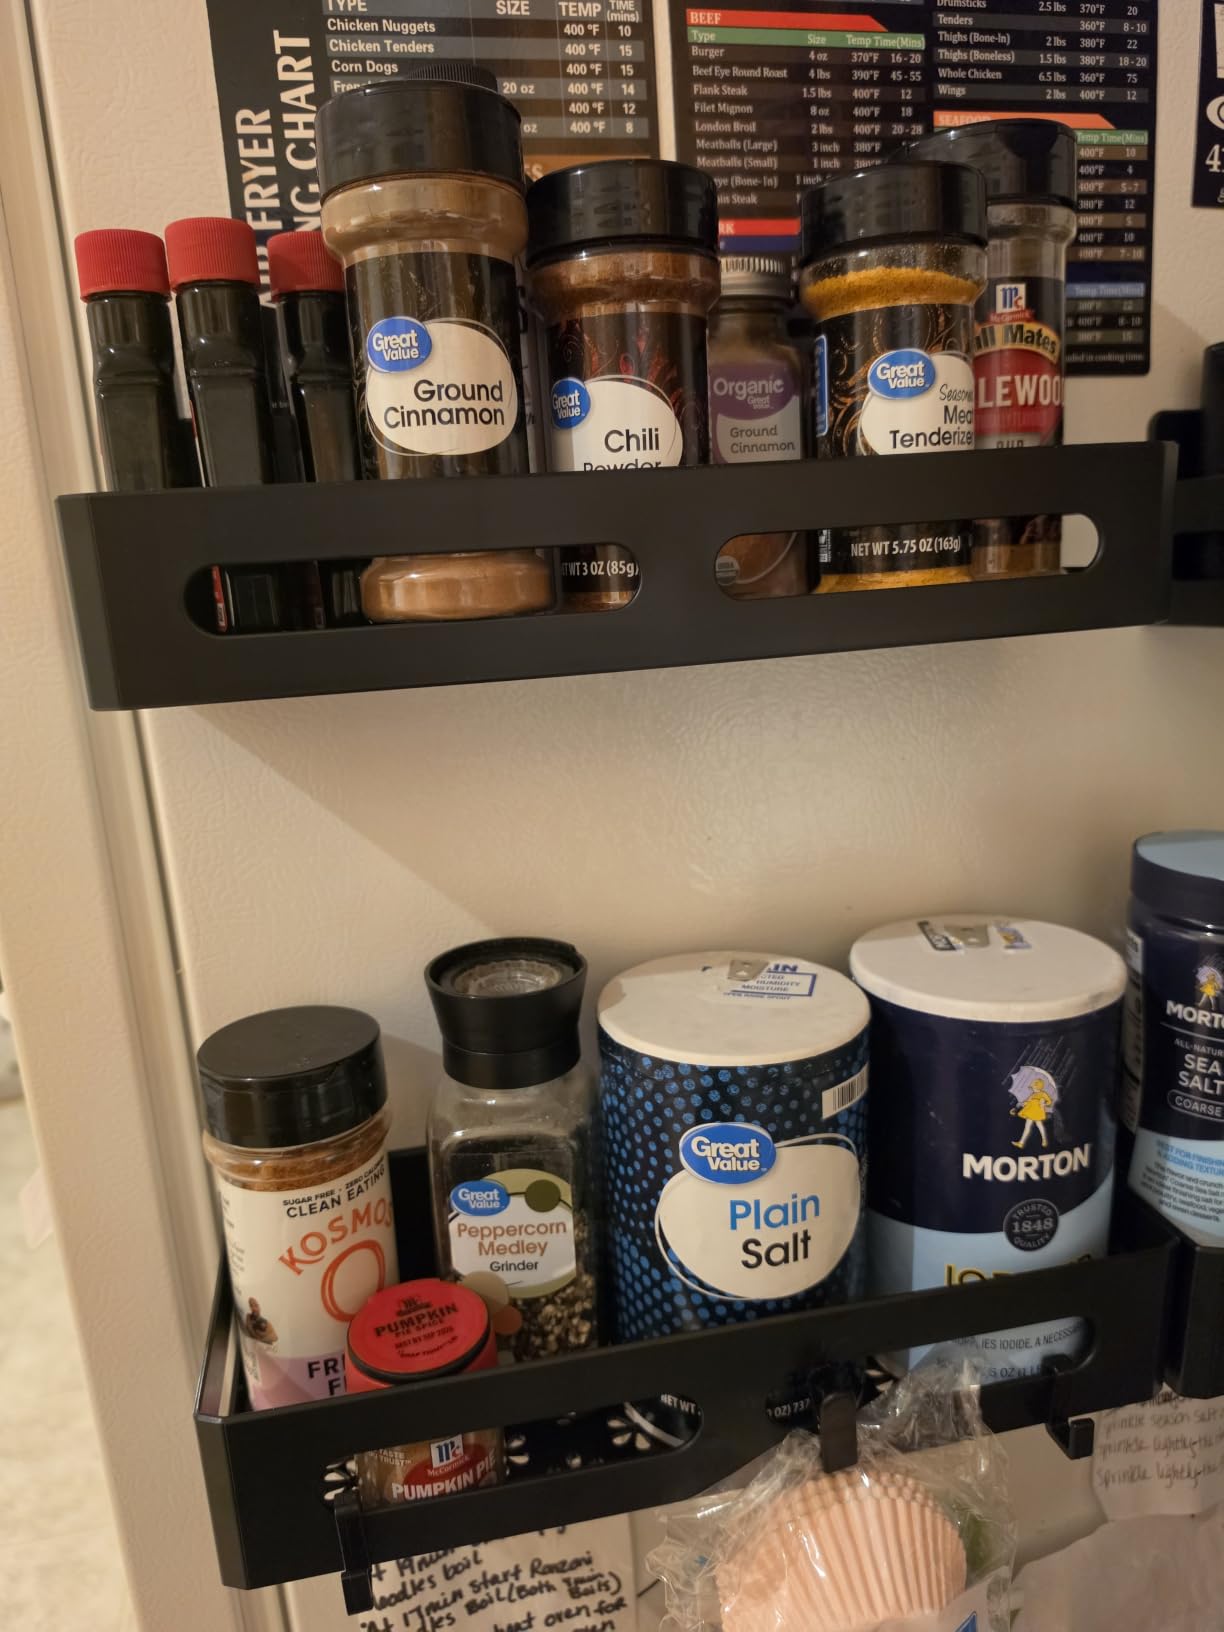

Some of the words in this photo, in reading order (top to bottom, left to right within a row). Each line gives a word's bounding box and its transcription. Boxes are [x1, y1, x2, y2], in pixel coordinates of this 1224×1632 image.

[327, 0, 368, 11] TYPE
[496, 1, 530, 16] SIZE
[558, 2, 601, 17] TEMP
[610, 0, 635, 11] TIME
[1127, 6, 1138, 15] 20
[607, 11, 639, 23] (mins)
[690, 12, 721, 24] BEEF
[937, 14, 973, 25] Tenders
[327, 18, 379, 32] Chicken
[382, 19, 436, 34] Nuggets
[564, 24, 584, 36] 400
[618, 25, 631, 37] 10
[691, 30, 716, 43] Type
[807, 34, 826, 45] Size
[845, 34, 871, 47] Temp
[938, 31, 968, 44] Thighs
[1053, 36, 1066, 46] lbs
[1127, 40, 1138, 49] 22
[329, 39, 380, 52] Chicken
[384, 40, 435, 53] Tenders
[565, 44, 586, 55] 400
[619, 45, 632, 57] 15
[691, 45, 724, 58] Burger
[938, 49, 968, 62] Thighs
[969, 50, 1015, 63] (Boneless)
[1053, 54, 1067, 64] lbs
[331, 60, 363, 73] Corn
[366, 60, 399, 75] Dogs
[566, 64, 587, 75] 400
[620, 65, 634, 76] 15
[692, 65, 713, 76] Beef
[714, 65, 730, 79] Eye
[732, 66, 761, 77] Round
[763, 67, 788, 78] Roast
[817, 69, 831, 79] lbs
[938, 67, 967, 79] Whole
[967, 68, 1002, 79] Chicken
[1053, 72, 1066, 82] lbs
[1126, 74, 1138, 83] 75
[503, 82, 517, 94] 20
[520, 85, 535, 94] oz
[568, 83, 588, 95] 400
[622, 84, 634, 95] 14
[693, 84, 720, 95] Flank
[721, 85, 748, 96] Steak
[901, 89, 912, 99] 12
[938, 84, 967, 97] Wings
[1127, 91, 1137, 100] 12
[273, 29, 317, 170] CHART
[569, 103, 589, 114] 400
[622, 103, 636, 115] 12
[694, 102, 715, 112] Filet
[717, 102, 753, 116] Mignon
[523, 124, 538, 133] oz
[570, 122, 590, 133] 400
[626, 122, 633, 133] 8
[695, 122, 731, 132] London
[235, 109, 283, 230] FRYER
[697, 157, 742, 167] Meatballs
[372, 330, 418, 350] Great
[1003, 324, 1057, 354] Mates
[383, 347, 419, 362] Value
[876, 361, 925, 380] Great
[414, 379, 504, 402] Ground
[713, 377, 785, 401] Organic
[888, 377, 925, 390] Value
[553, 391, 581, 408] Great
[384, 406, 505, 429] Cinnamon
[557, 405, 581, 419] Value
[943, 405, 974, 425] Mea
[730, 425, 778, 438] Ground
[889, 427, 974, 449] Tenderize
[604, 428, 660, 453] Chili
[730, 441, 796, 454] Cinnamon
[851, 543, 869, 556] NET
[872, 541, 890, 555] WT
[892, 539, 917, 554] 5.75
[919, 538, 933, 552] OZ
[934, 536, 961, 553] (163g)
[570, 562, 582, 575] WT
[582, 561, 588, 576] 3
[591, 561, 605, 575] OZ
[607, 560, 639, 577] (85g)
[1166, 1000, 1224, 1029] MORT
[1183, 1053, 1222, 1077] SEA
[1175, 1095, 1222, 1118] COARSE
[690, 1135, 760, 1158] Great
[707, 1156, 760, 1172] Value
[962, 1144, 1091, 1182] MORTON
[283, 1196, 312, 1206] SUGAR
[315, 1189, 336, 1200] FREE
[345, 1175, 363, 1189] ZERO
[287, 1195, 340, 1218] CLEAN
[347, 1164, 385, 1201] EATING
[458, 1188, 500, 1201] Great
[468, 1199, 500, 1209] Value
[729, 1194, 820, 1231] Plain
[1012, 1203, 1052, 1219] TRUSTED
[457, 1220, 567, 1242] Peppercorn
[1011, 1218, 1053, 1232] 1848
[478, 1240, 548, 1258] Medley
[741, 1229, 811, 1270] Salt
[489, 1260, 539, 1273] Grinder
[374, 1302, 458, 1337] PUMPKIN
[679, 1400, 696, 1415] WT
[392, 1469, 475, 1500] PUMPKIN
[477, 1449, 496, 1480] PIE
